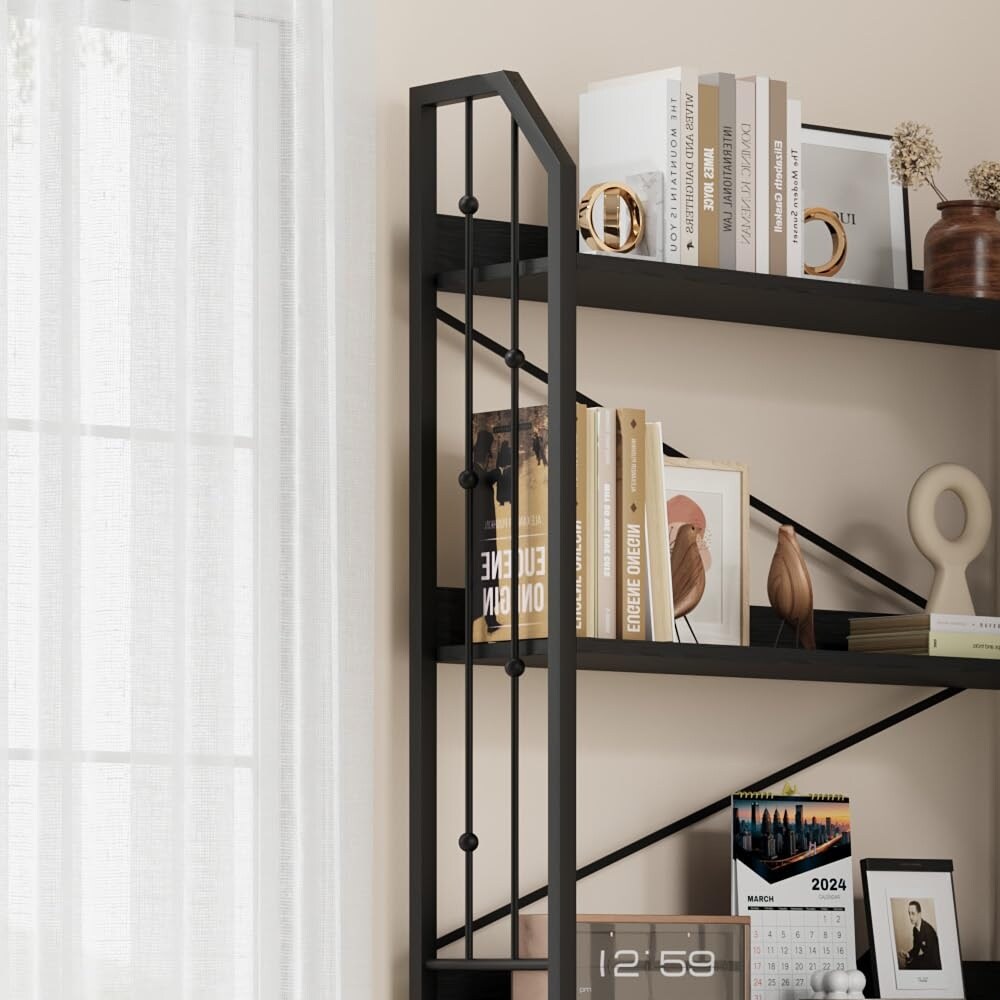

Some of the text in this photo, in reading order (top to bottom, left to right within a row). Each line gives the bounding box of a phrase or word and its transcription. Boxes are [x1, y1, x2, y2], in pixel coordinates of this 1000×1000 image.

[811, 878, 847, 891] 2024
[747, 895, 774, 903] MARCH
[767, 947, 774, 955] 11
[781, 947, 788, 955] 12
[795, 947, 802, 955] 13
[809, 947, 817, 955] 14
[823, 947, 830, 955] 15
[837, 947, 844, 955] 16
[754, 963, 844, 971] 17 18 19 20 21 22 23
[753, 978, 804, 986] 24 25 26 27
